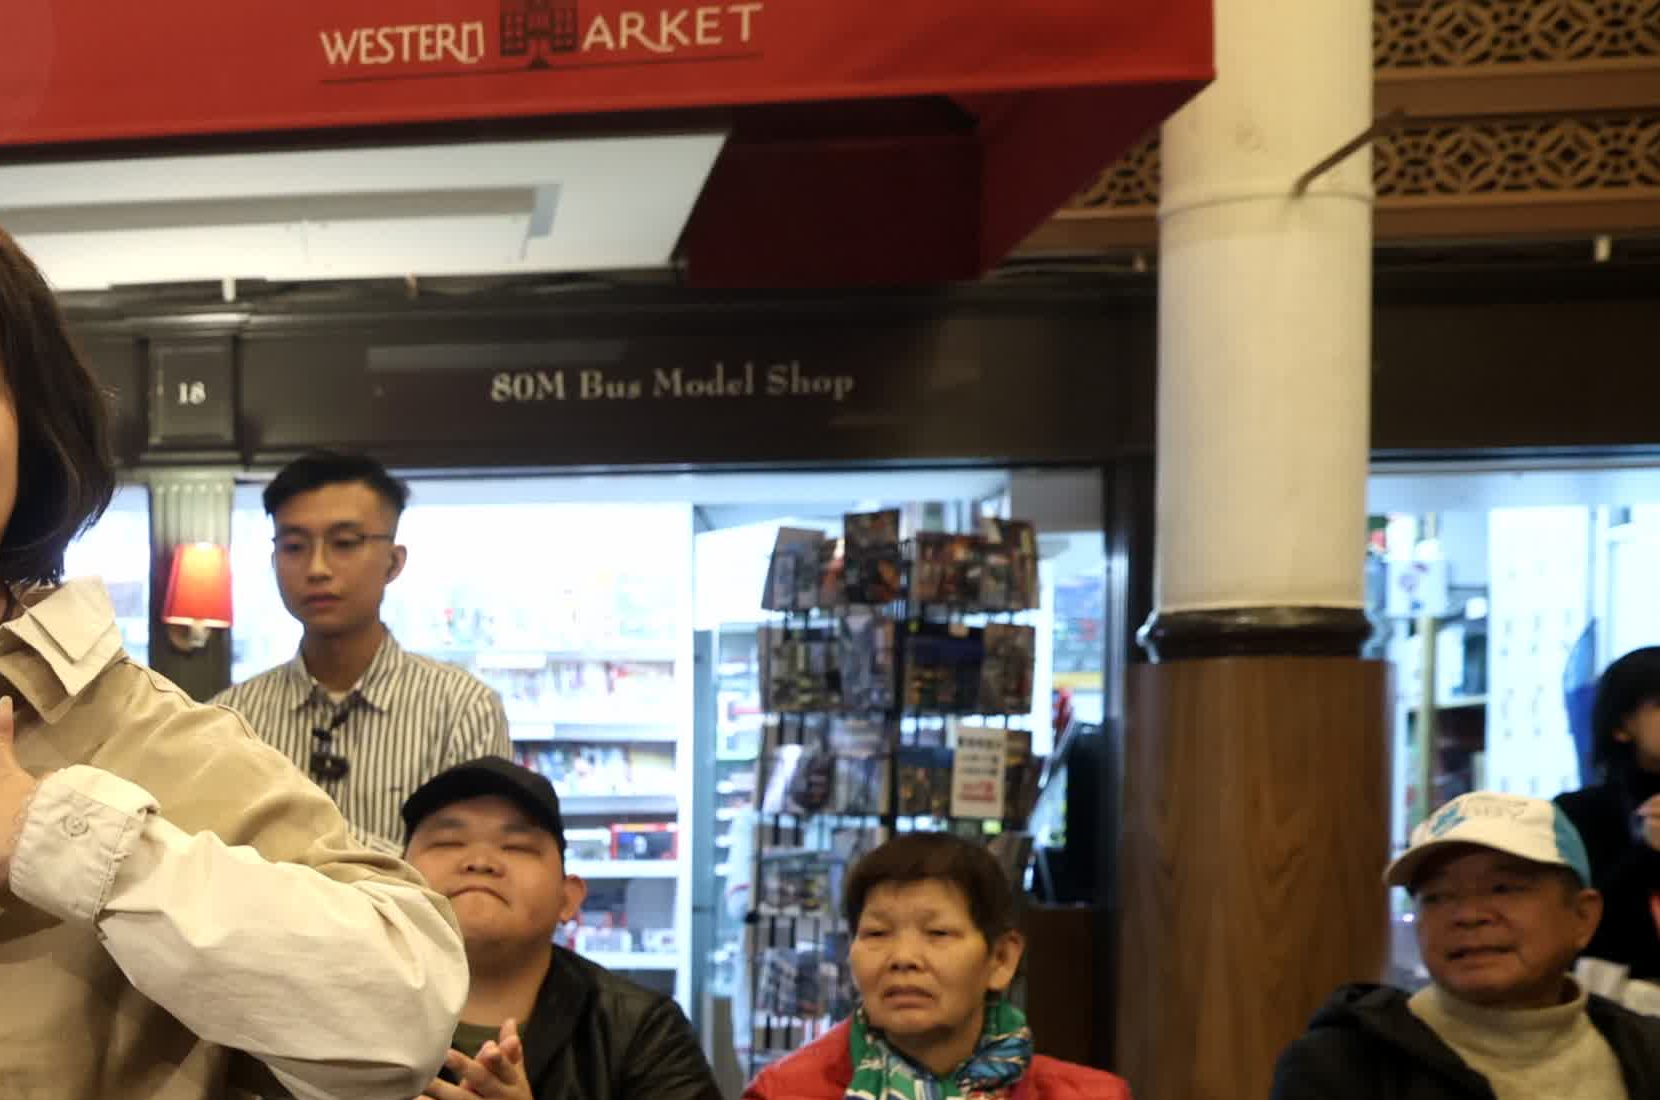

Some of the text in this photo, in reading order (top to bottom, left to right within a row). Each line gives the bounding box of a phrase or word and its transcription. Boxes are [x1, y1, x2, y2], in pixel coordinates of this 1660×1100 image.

[319, 22, 486, 66] WESTERN
[178, 381, 206, 405] 18
[490, 360, 855, 402] 80M Bus Model Shop
